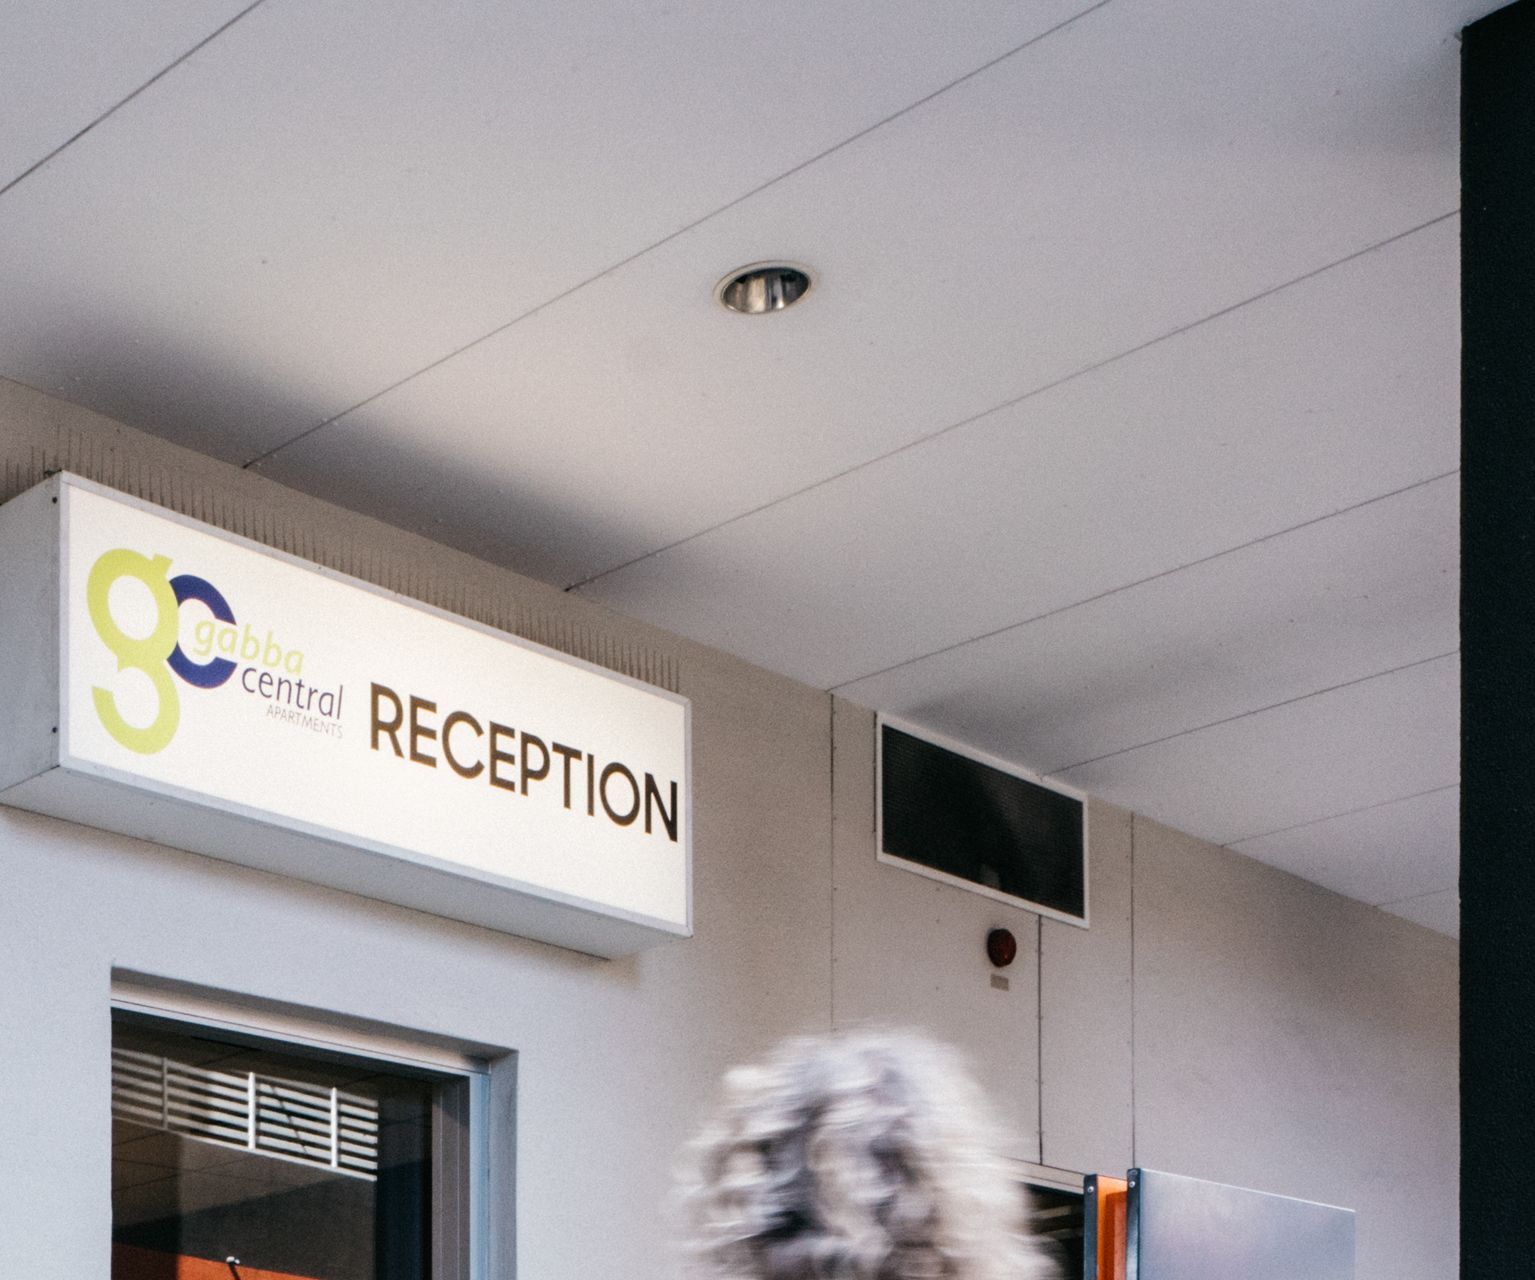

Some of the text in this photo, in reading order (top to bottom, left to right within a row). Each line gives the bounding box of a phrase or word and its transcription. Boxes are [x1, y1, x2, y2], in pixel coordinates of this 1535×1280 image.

[192, 619, 305, 677] gabba
[241, 666, 344, 720] central
[265, 703, 344, 740] APARTMENTS
[369, 681, 679, 843] RECEPTION
